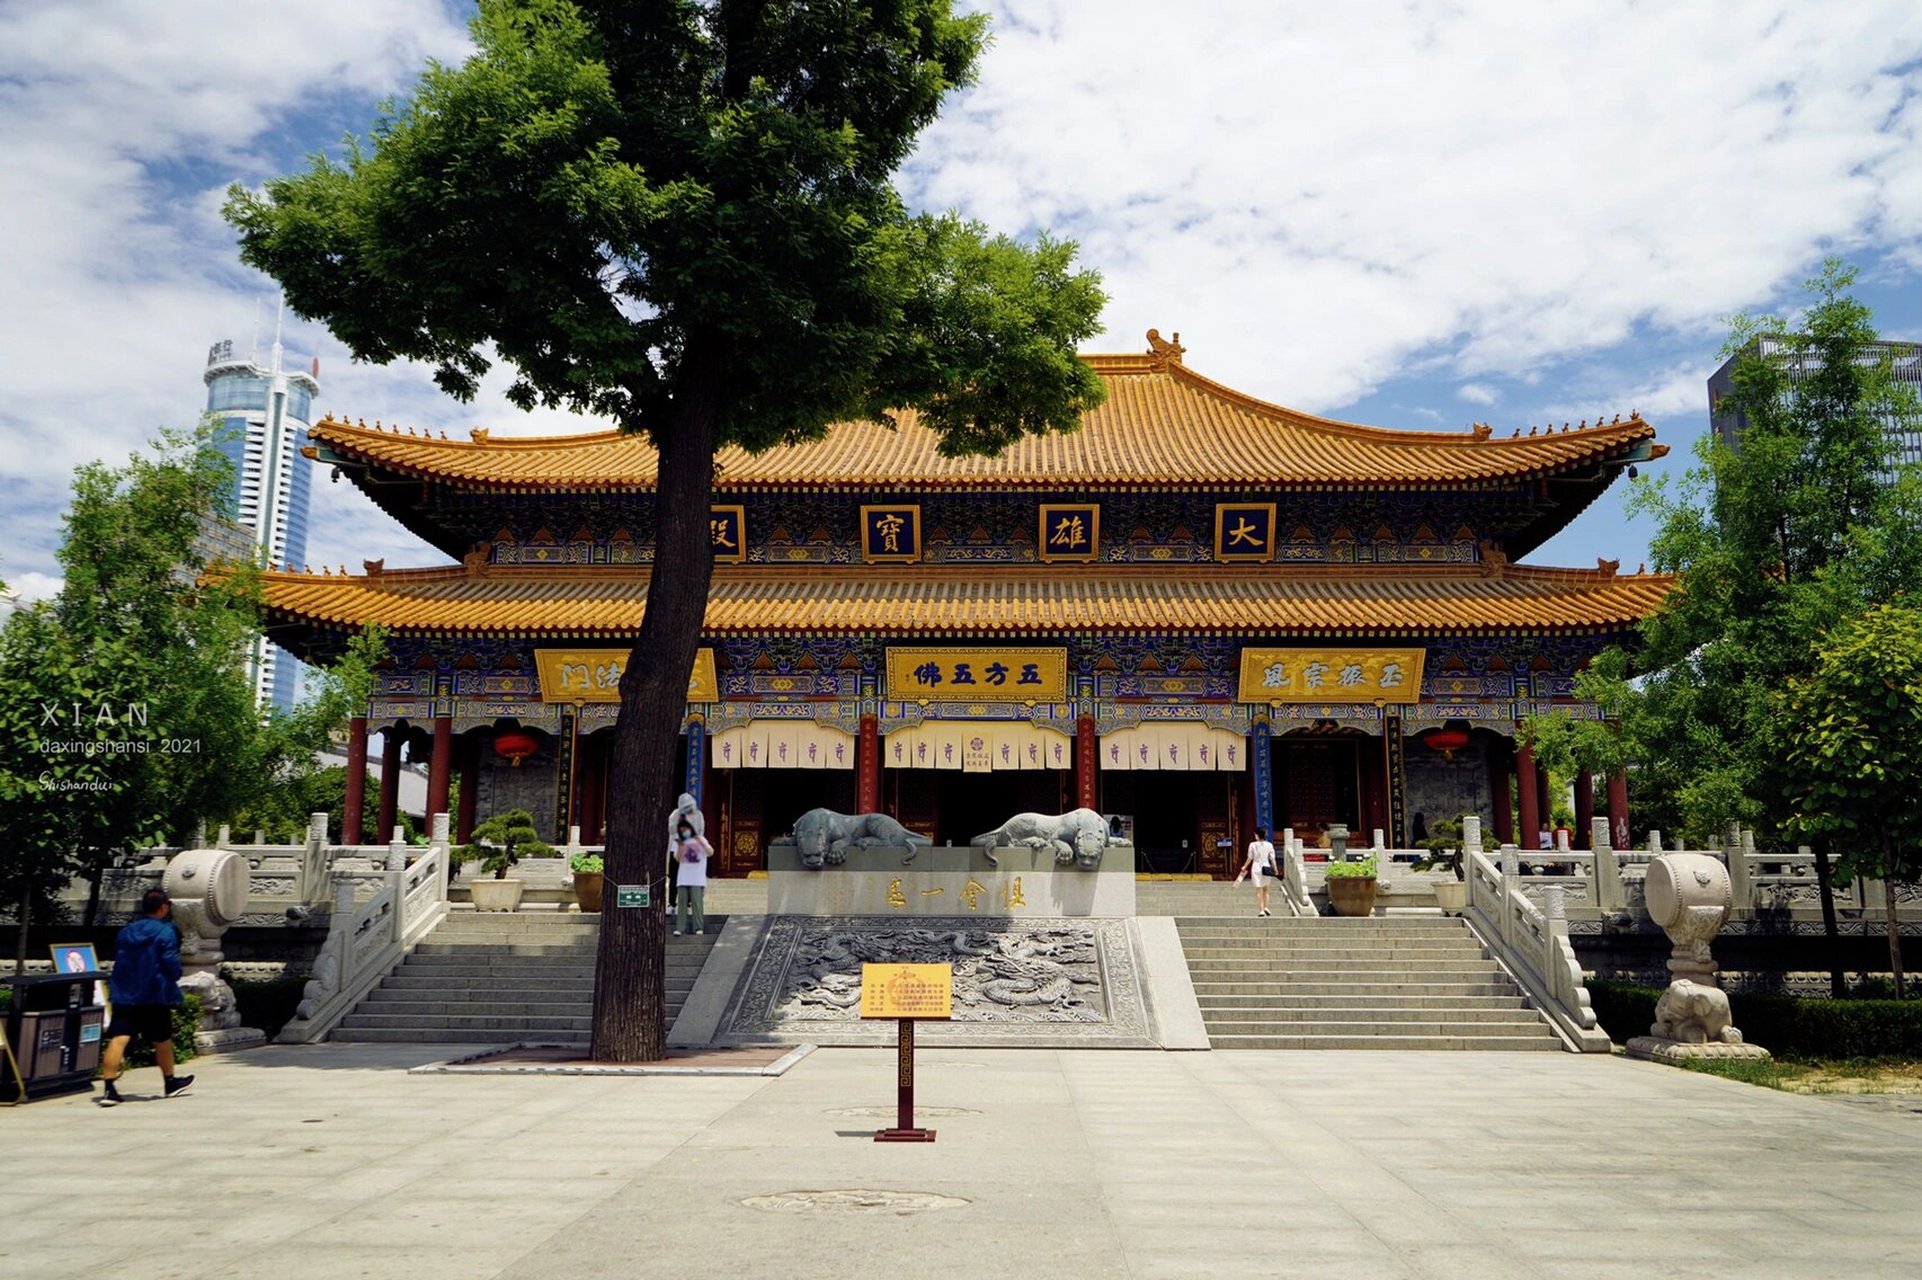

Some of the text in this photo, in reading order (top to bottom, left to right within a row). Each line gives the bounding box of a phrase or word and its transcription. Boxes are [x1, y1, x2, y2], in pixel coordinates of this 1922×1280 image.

[876, 514, 905, 552] 寶
[1049, 515, 1087, 549] 雄
[1228, 516, 1265, 547] 大
